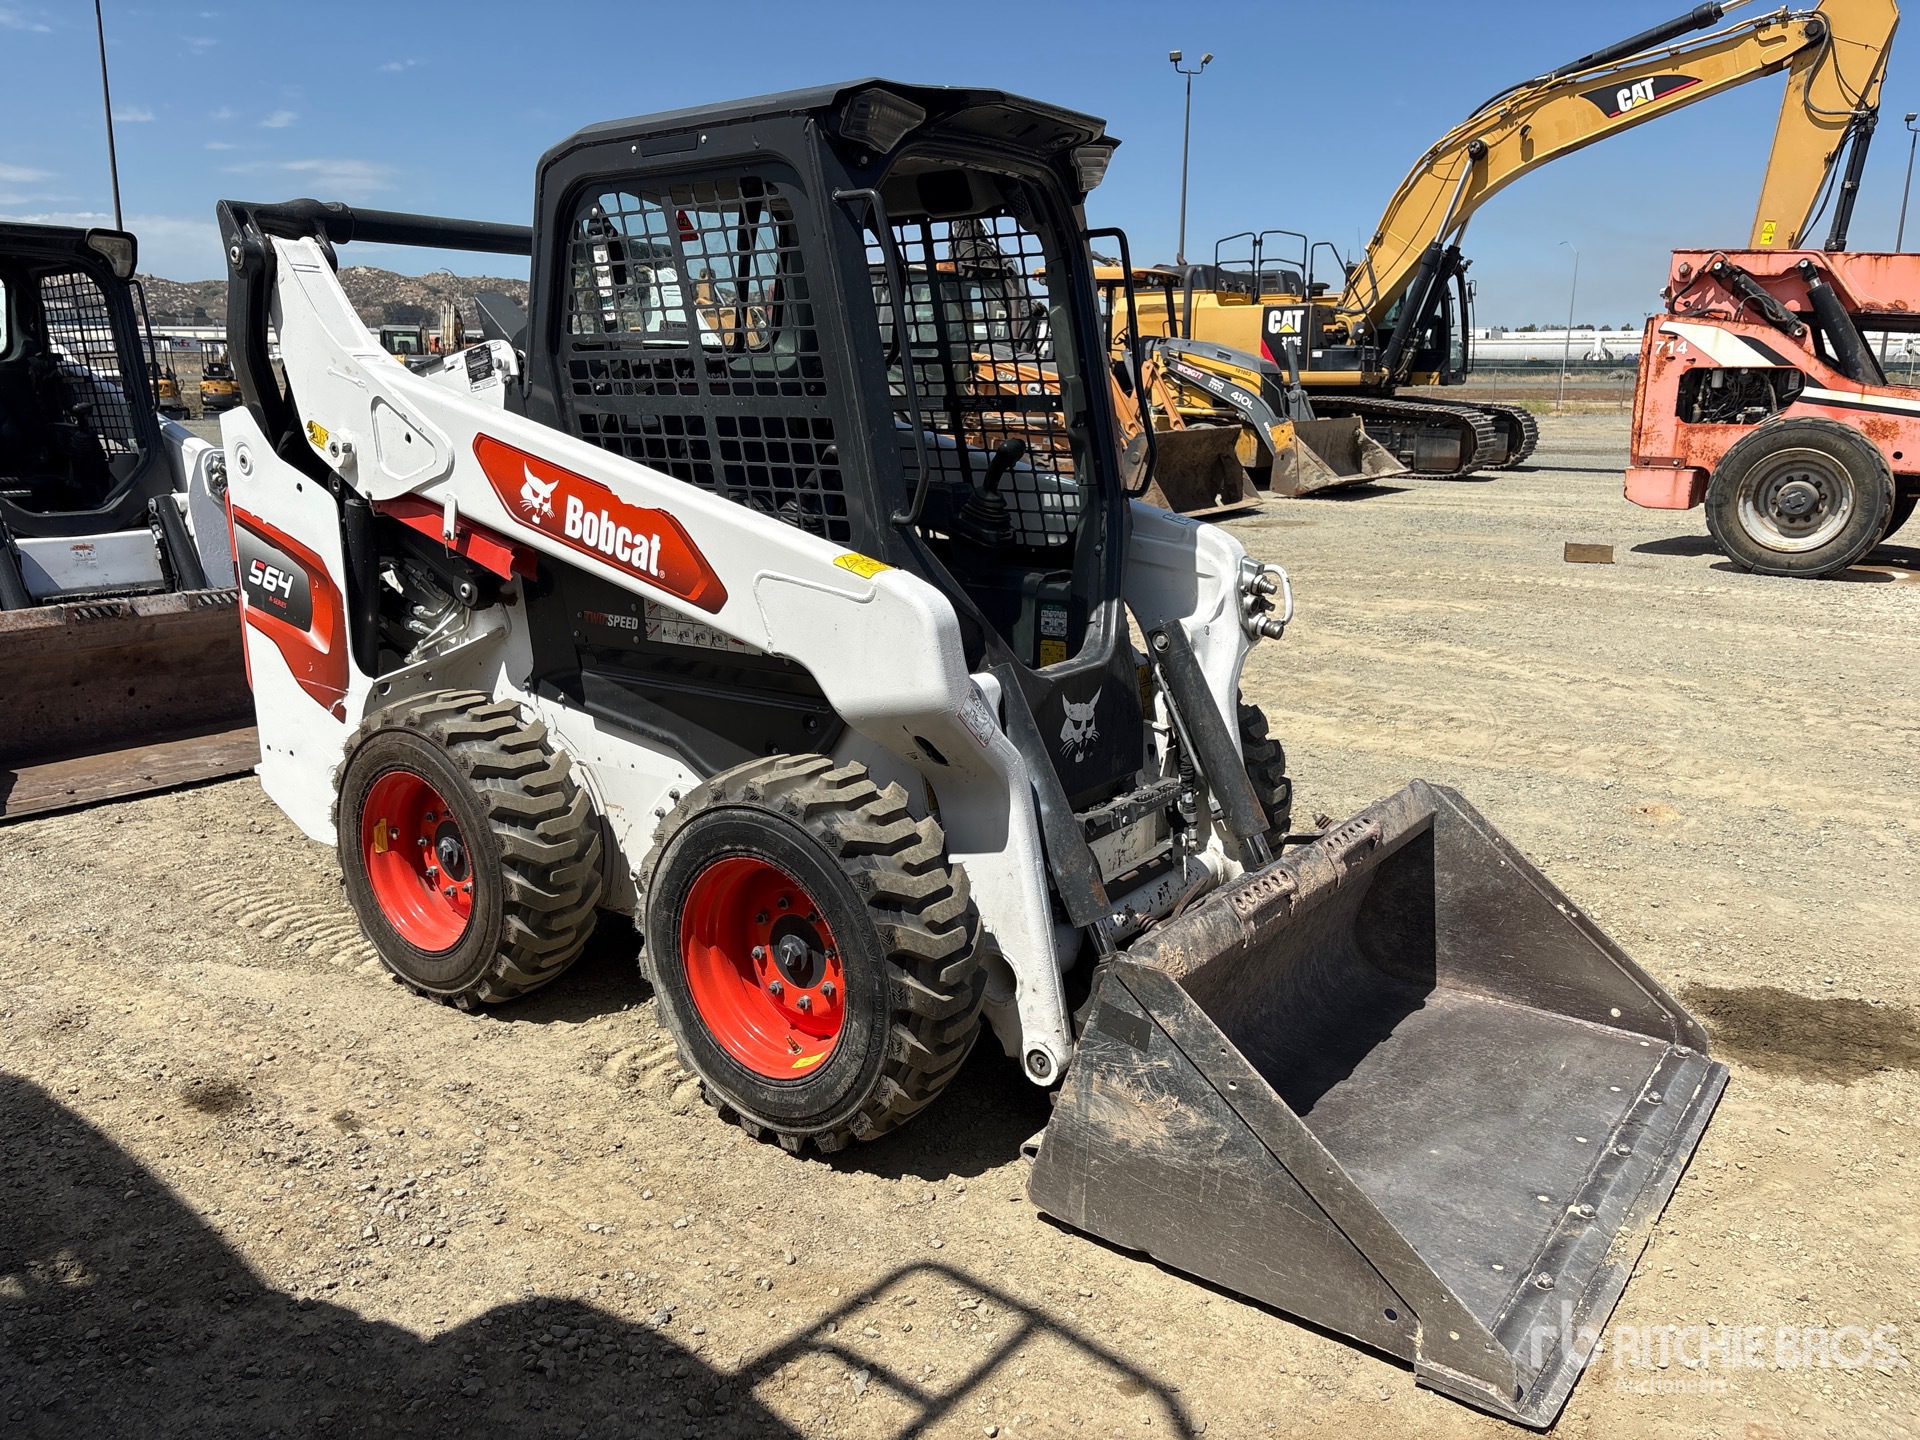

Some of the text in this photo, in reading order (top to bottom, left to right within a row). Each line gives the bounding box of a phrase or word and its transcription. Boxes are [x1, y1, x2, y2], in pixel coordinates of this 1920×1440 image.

[1616, 77, 1655, 112] CAT
[1268, 310, 1305, 334] CAT
[1655, 341, 1688, 355] 714
[1230, 391, 1253, 410] 410L
[564, 494, 662, 577] Bobcat
[248, 559, 294, 599] S64
[607, 615, 639, 630] SPEED
